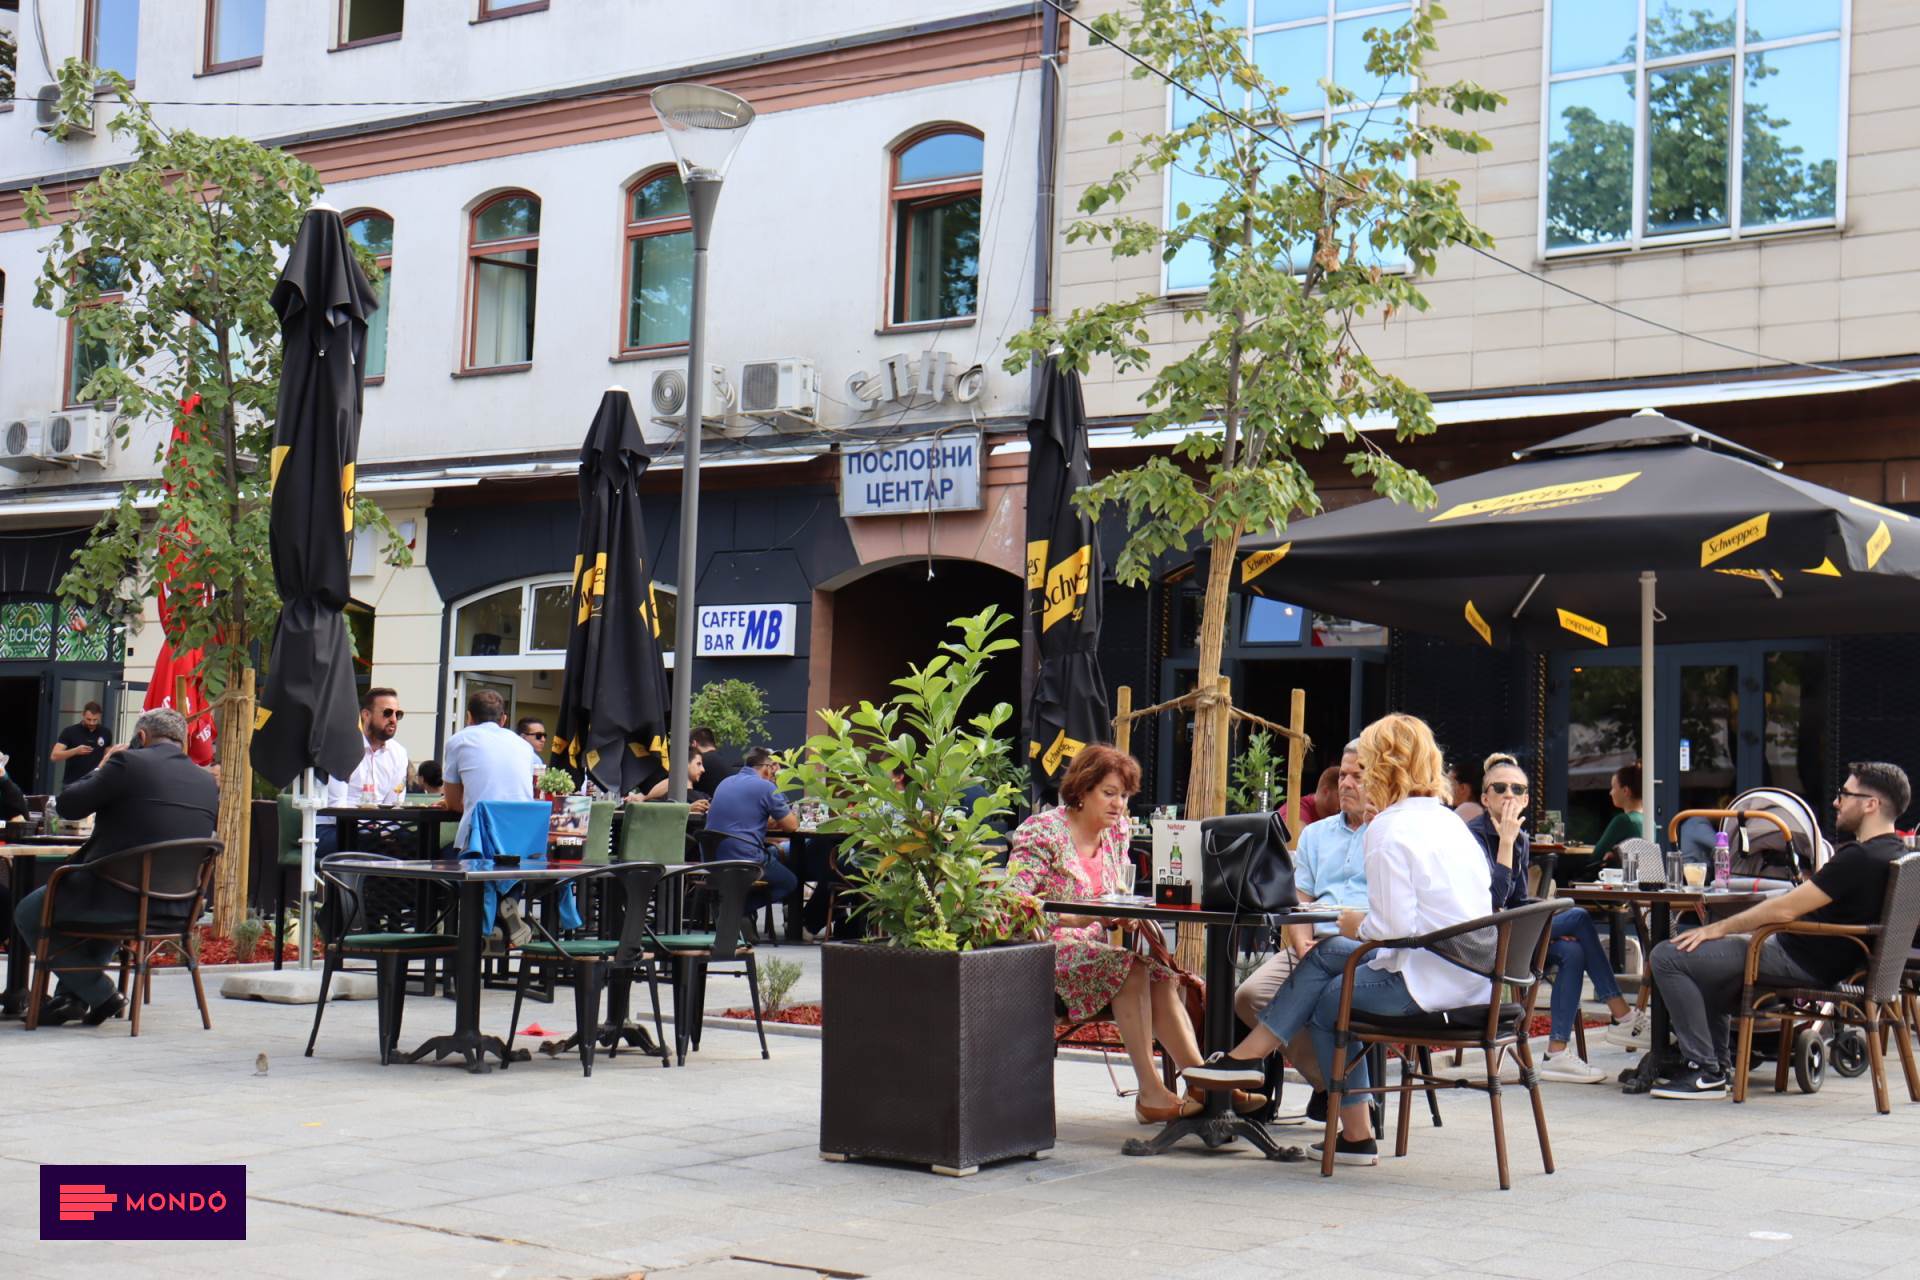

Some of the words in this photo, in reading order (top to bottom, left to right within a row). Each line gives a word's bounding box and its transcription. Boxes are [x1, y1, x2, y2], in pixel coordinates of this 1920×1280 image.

[848, 444, 973, 475] ПОСЛОВНИ
[866, 478, 953, 507] ЦЕНТАР
[1708, 525, 1760, 556] Schweppes
[702, 611, 746, 628] CAFFE
[742, 609, 783, 650] MB
[9, 627, 42, 643] BOHO
[704, 634, 734, 650] BAR
